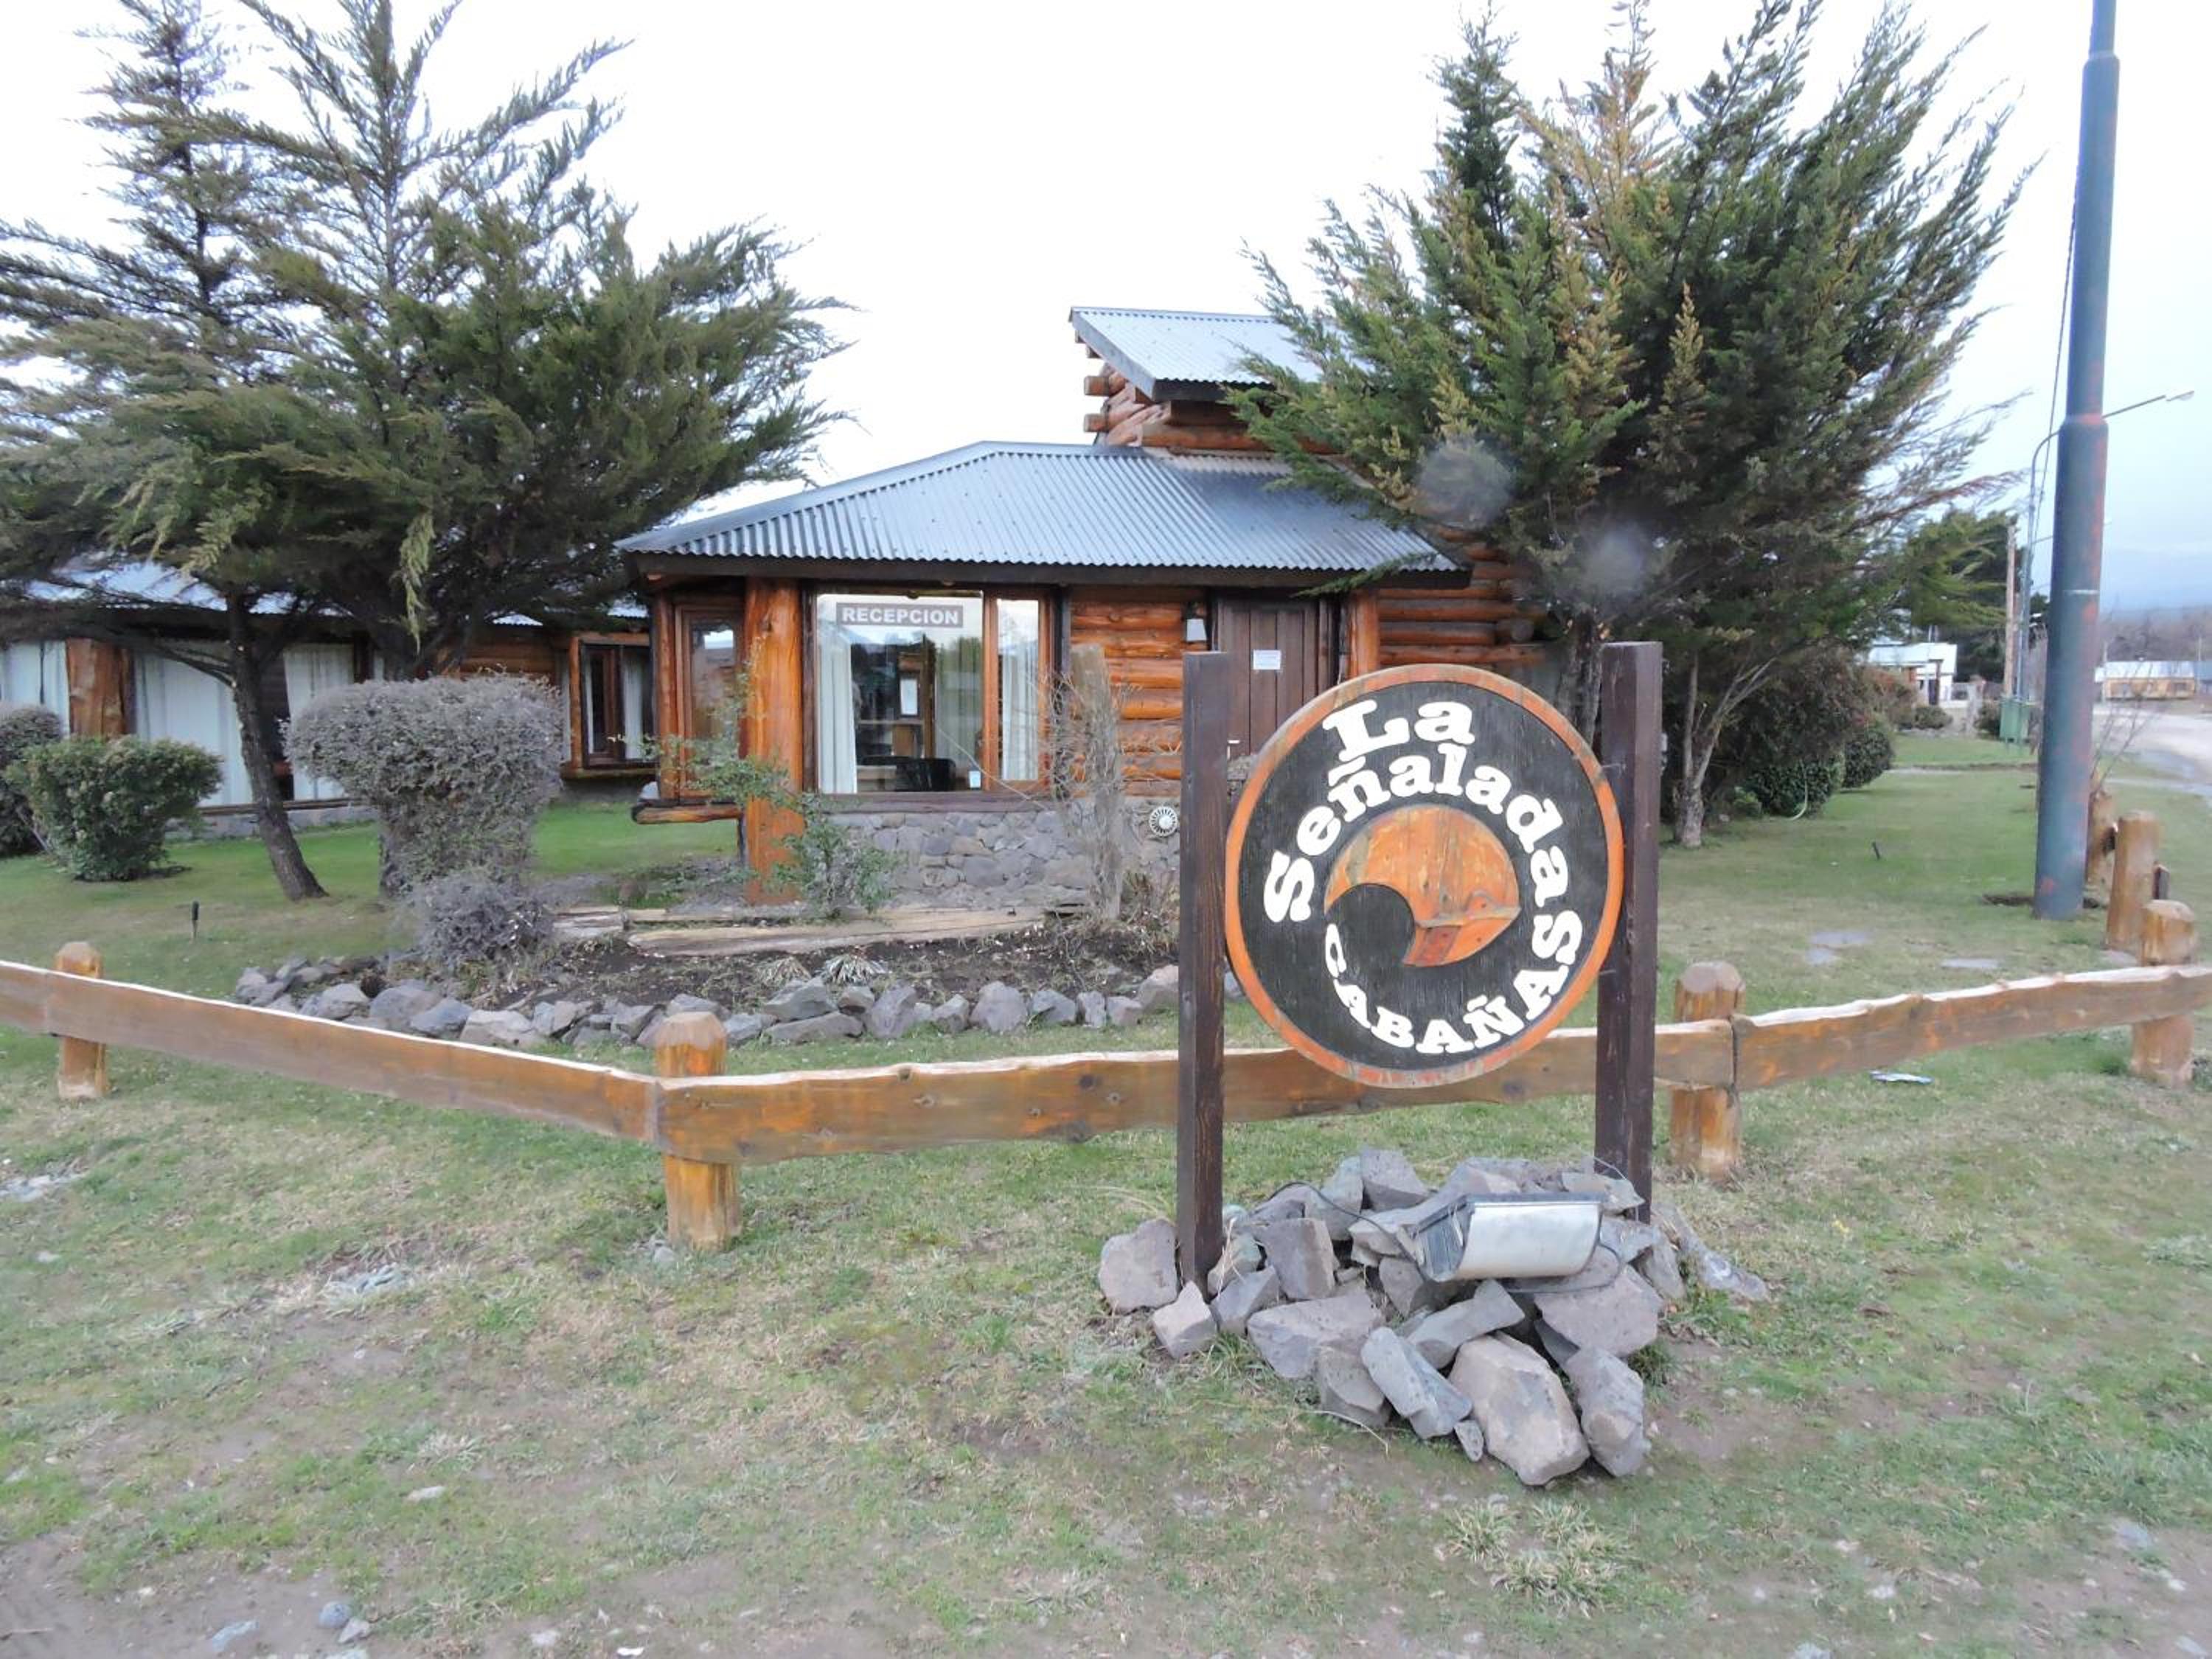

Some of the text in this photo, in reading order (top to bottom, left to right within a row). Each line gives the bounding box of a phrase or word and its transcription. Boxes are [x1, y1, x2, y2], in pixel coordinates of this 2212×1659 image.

[842, 607, 959, 625] RECEPCION
[1322, 699, 1475, 761] La
[1263, 742, 1568, 922] Señalada
[1324, 909, 1583, 1054] CABAÑAS
